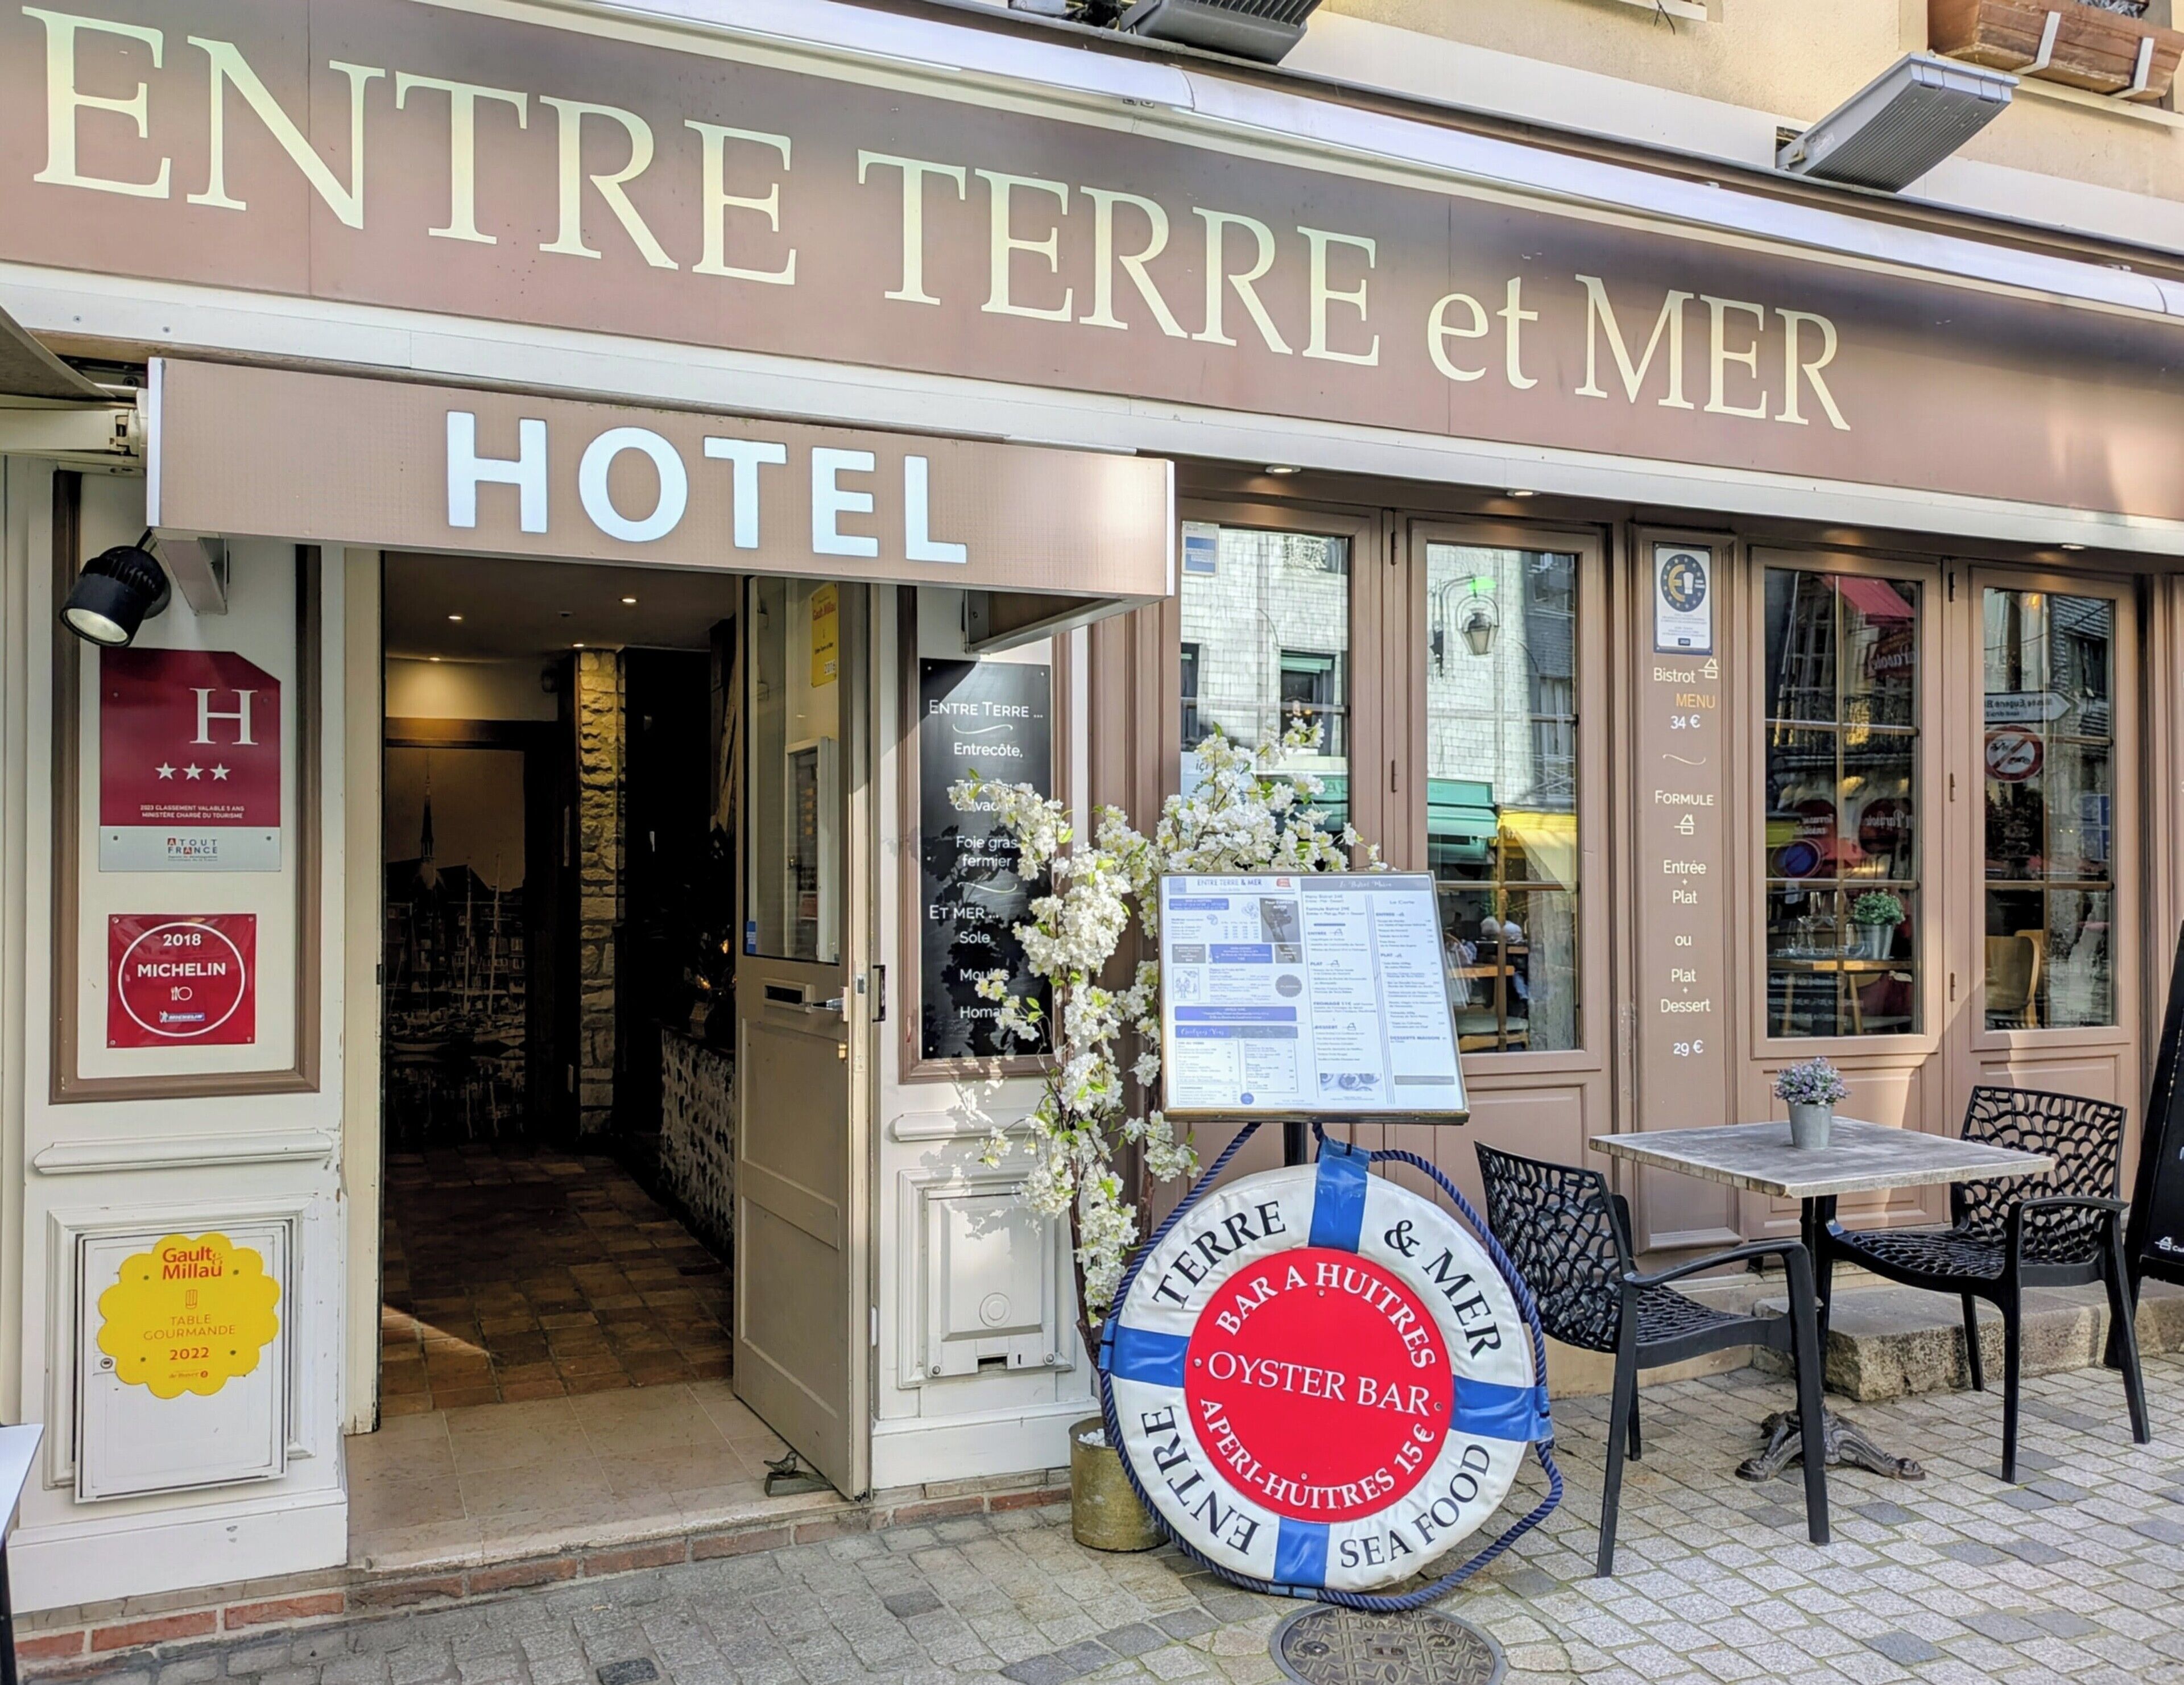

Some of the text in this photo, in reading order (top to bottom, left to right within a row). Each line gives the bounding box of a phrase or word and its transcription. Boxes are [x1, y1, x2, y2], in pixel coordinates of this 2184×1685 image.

[22, 5, 1851, 431] ENTRE TERRE et MER
[446, 410, 967, 563] HOTEL
[1654, 667, 1695, 683] Bistrot
[1676, 693, 1715, 709] MENU
[189, 687, 258, 745] H
[954, 742, 1023, 758] Entrecôte,
[956, 835, 1018, 851] Foie gras
[962, 853, 1012, 868] fermier
[1664, 860, 1706, 874] Entrée
[1673, 890, 1698, 905] Plat
[163, 933, 202, 947] 2018
[959, 931, 991, 944] Sole
[1674, 935, 1692, 947] ou
[137, 963, 226, 977] MICHELIN
[1671, 968, 1697, 982] Plat
[1660, 998, 1711, 1013] Dessert
[163, 1263, 222, 1280] Millau
[171, 1314, 211, 1326] TABLE
[1215, 1261, 1437, 1370] BAR A HUITRES
[143, 1324, 237, 1341] GOURMANDE
[169, 1347, 210, 1361] 2022
[1141, 1200, 1503, 1555] ENTRE TERRE & MER
[1207, 1351, 1430, 1417] OYSTER BAR
[1340, 1443, 1491, 1569] SEA FOOD
